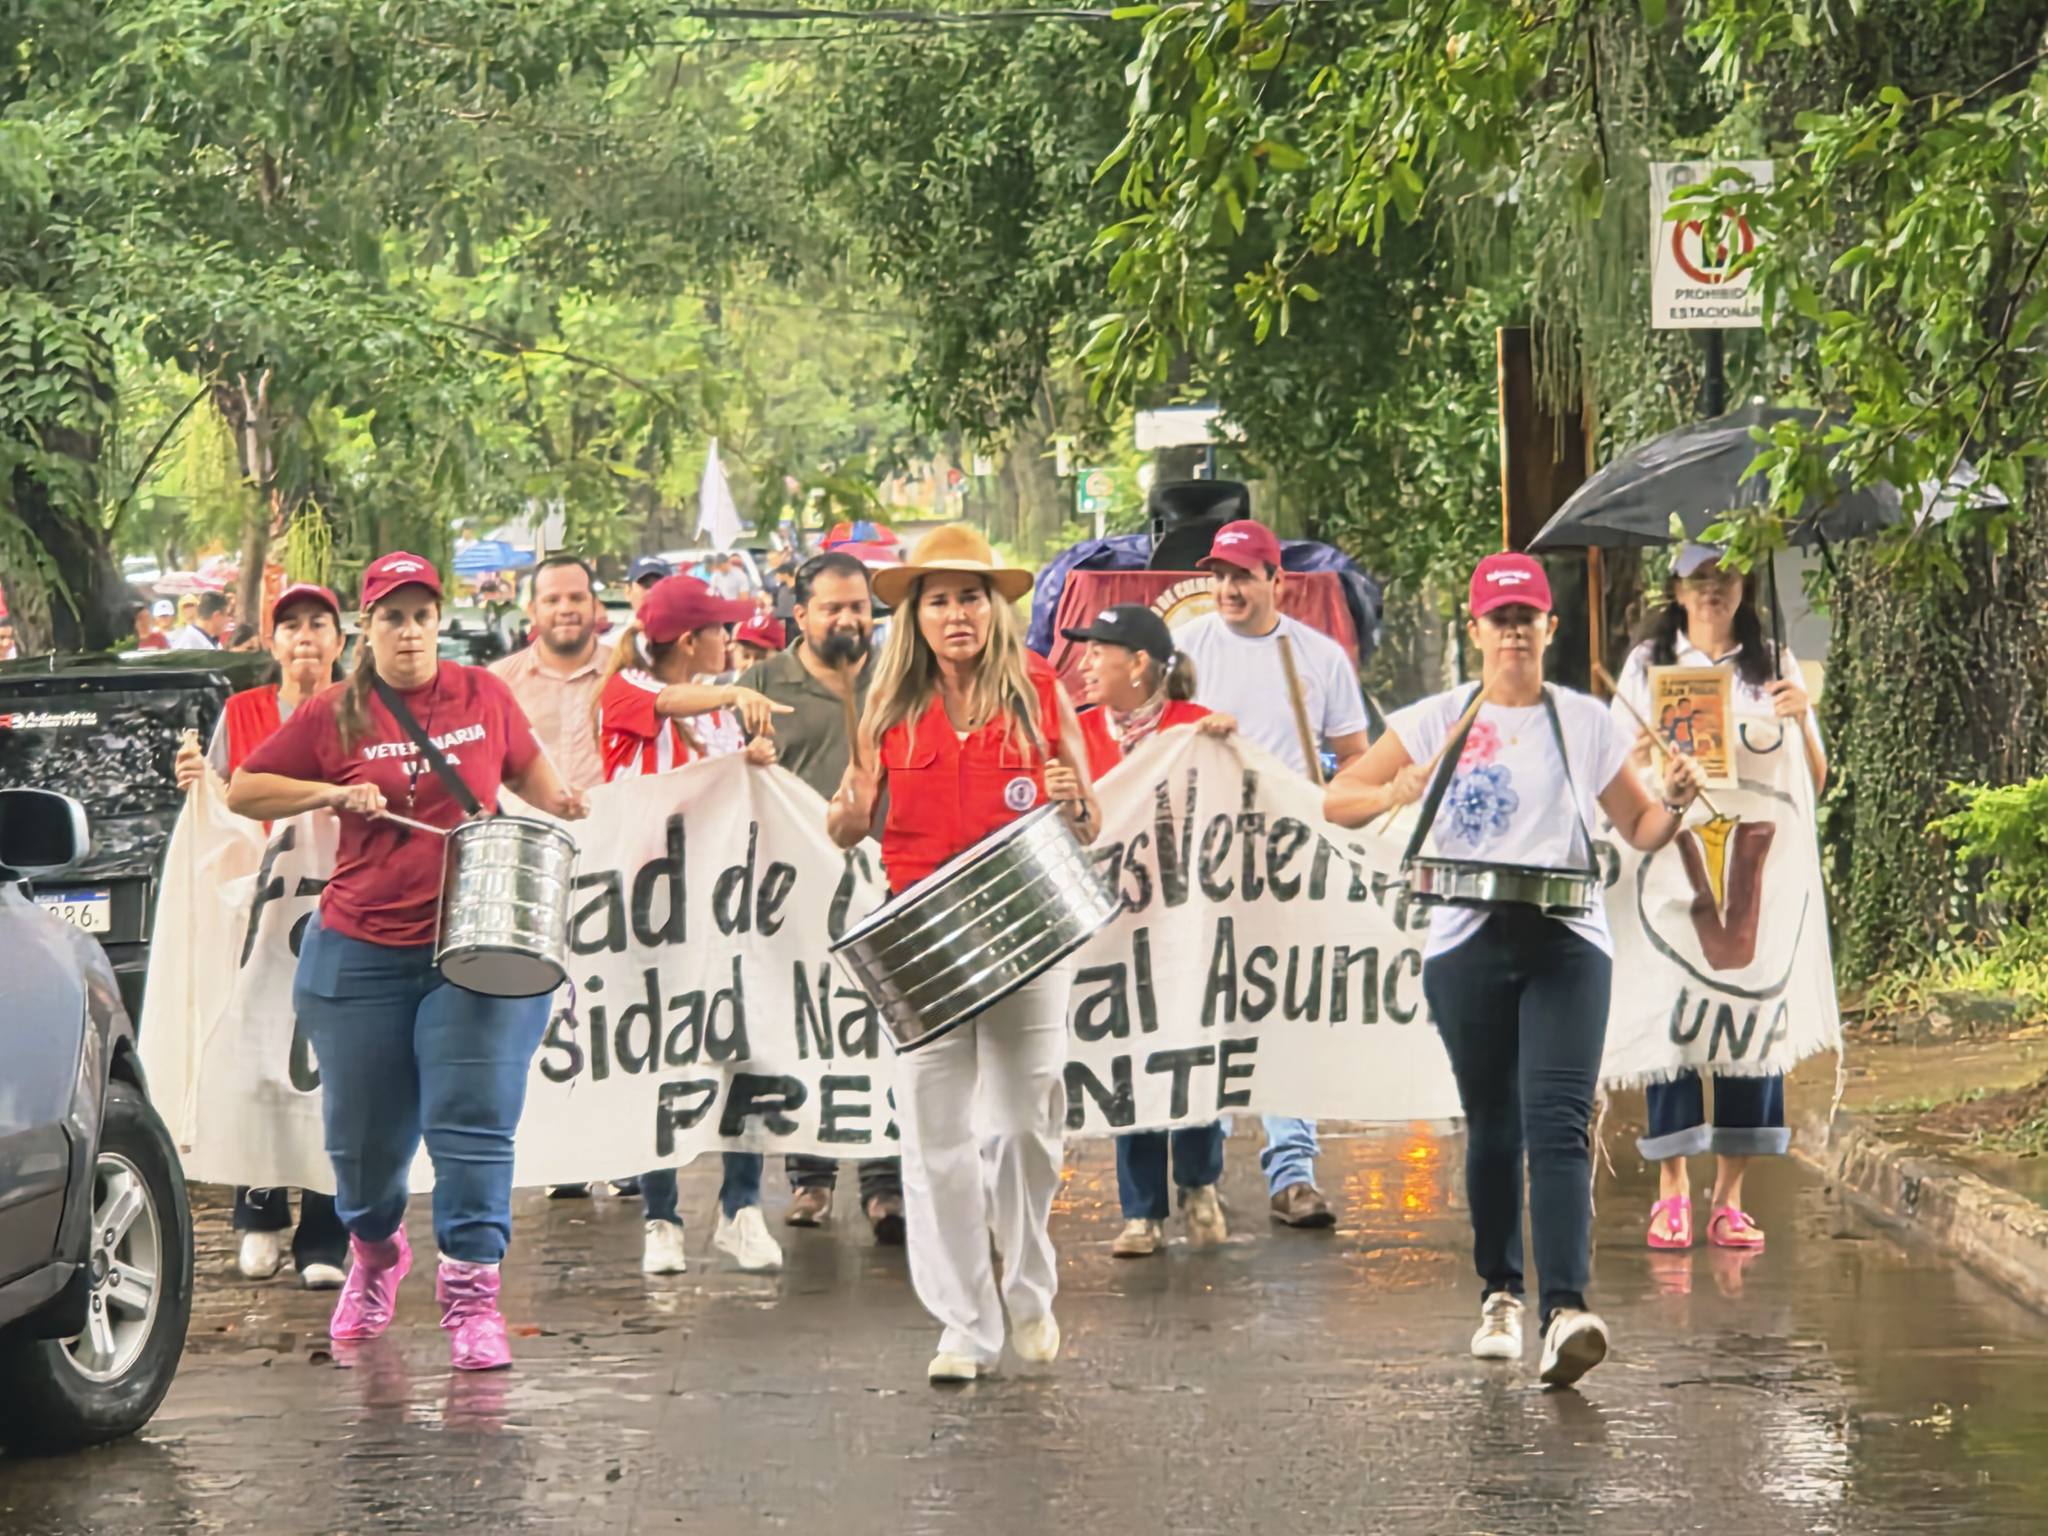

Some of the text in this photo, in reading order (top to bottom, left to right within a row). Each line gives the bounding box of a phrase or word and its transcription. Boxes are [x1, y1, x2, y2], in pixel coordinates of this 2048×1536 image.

[1675, 288, 1745, 300] PROHIBID
[364, 723, 487, 760] VETERNARIA
[712, 820, 797, 937] de
[1669, 986, 1789, 1062] UNA
